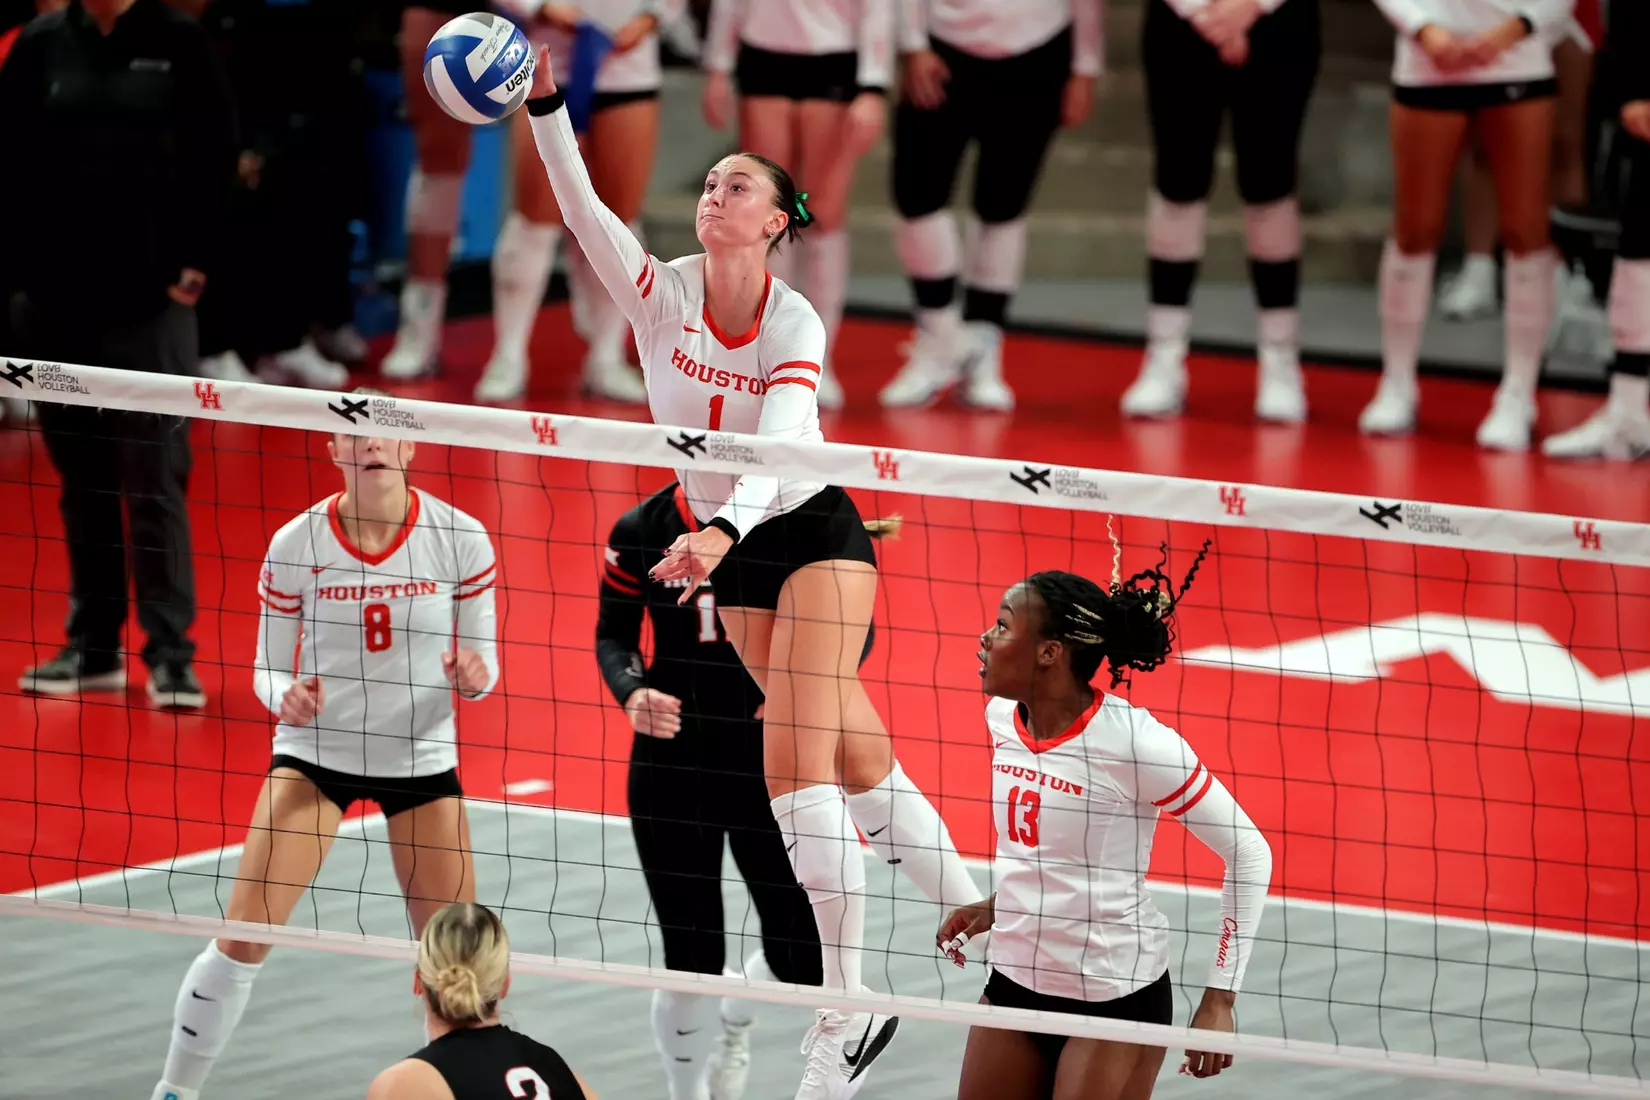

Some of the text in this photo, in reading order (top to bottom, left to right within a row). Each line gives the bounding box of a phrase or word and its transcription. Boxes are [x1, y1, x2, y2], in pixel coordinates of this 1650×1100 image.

[37, 372, 79, 384] HOUSTON
[38, 381, 92, 394] VOLLEYBALL
[193, 381, 223, 410] UH
[373, 407, 414, 420] HOUSTON
[373, 416, 426, 430] VOLLEYBALL
[708, 394, 725, 431] 1
[530, 415, 558, 445] UH
[710, 443, 754, 454] HOUSTON
[711, 451, 765, 466] VOLLEYBALL
[872, 450, 899, 480] UH
[1219, 485, 1247, 516] UH
[1573, 520, 1602, 551] UH
[316, 582, 437, 601] HOUSTON
[364, 603, 392, 653] 8
[1007, 785, 1041, 848] 13
